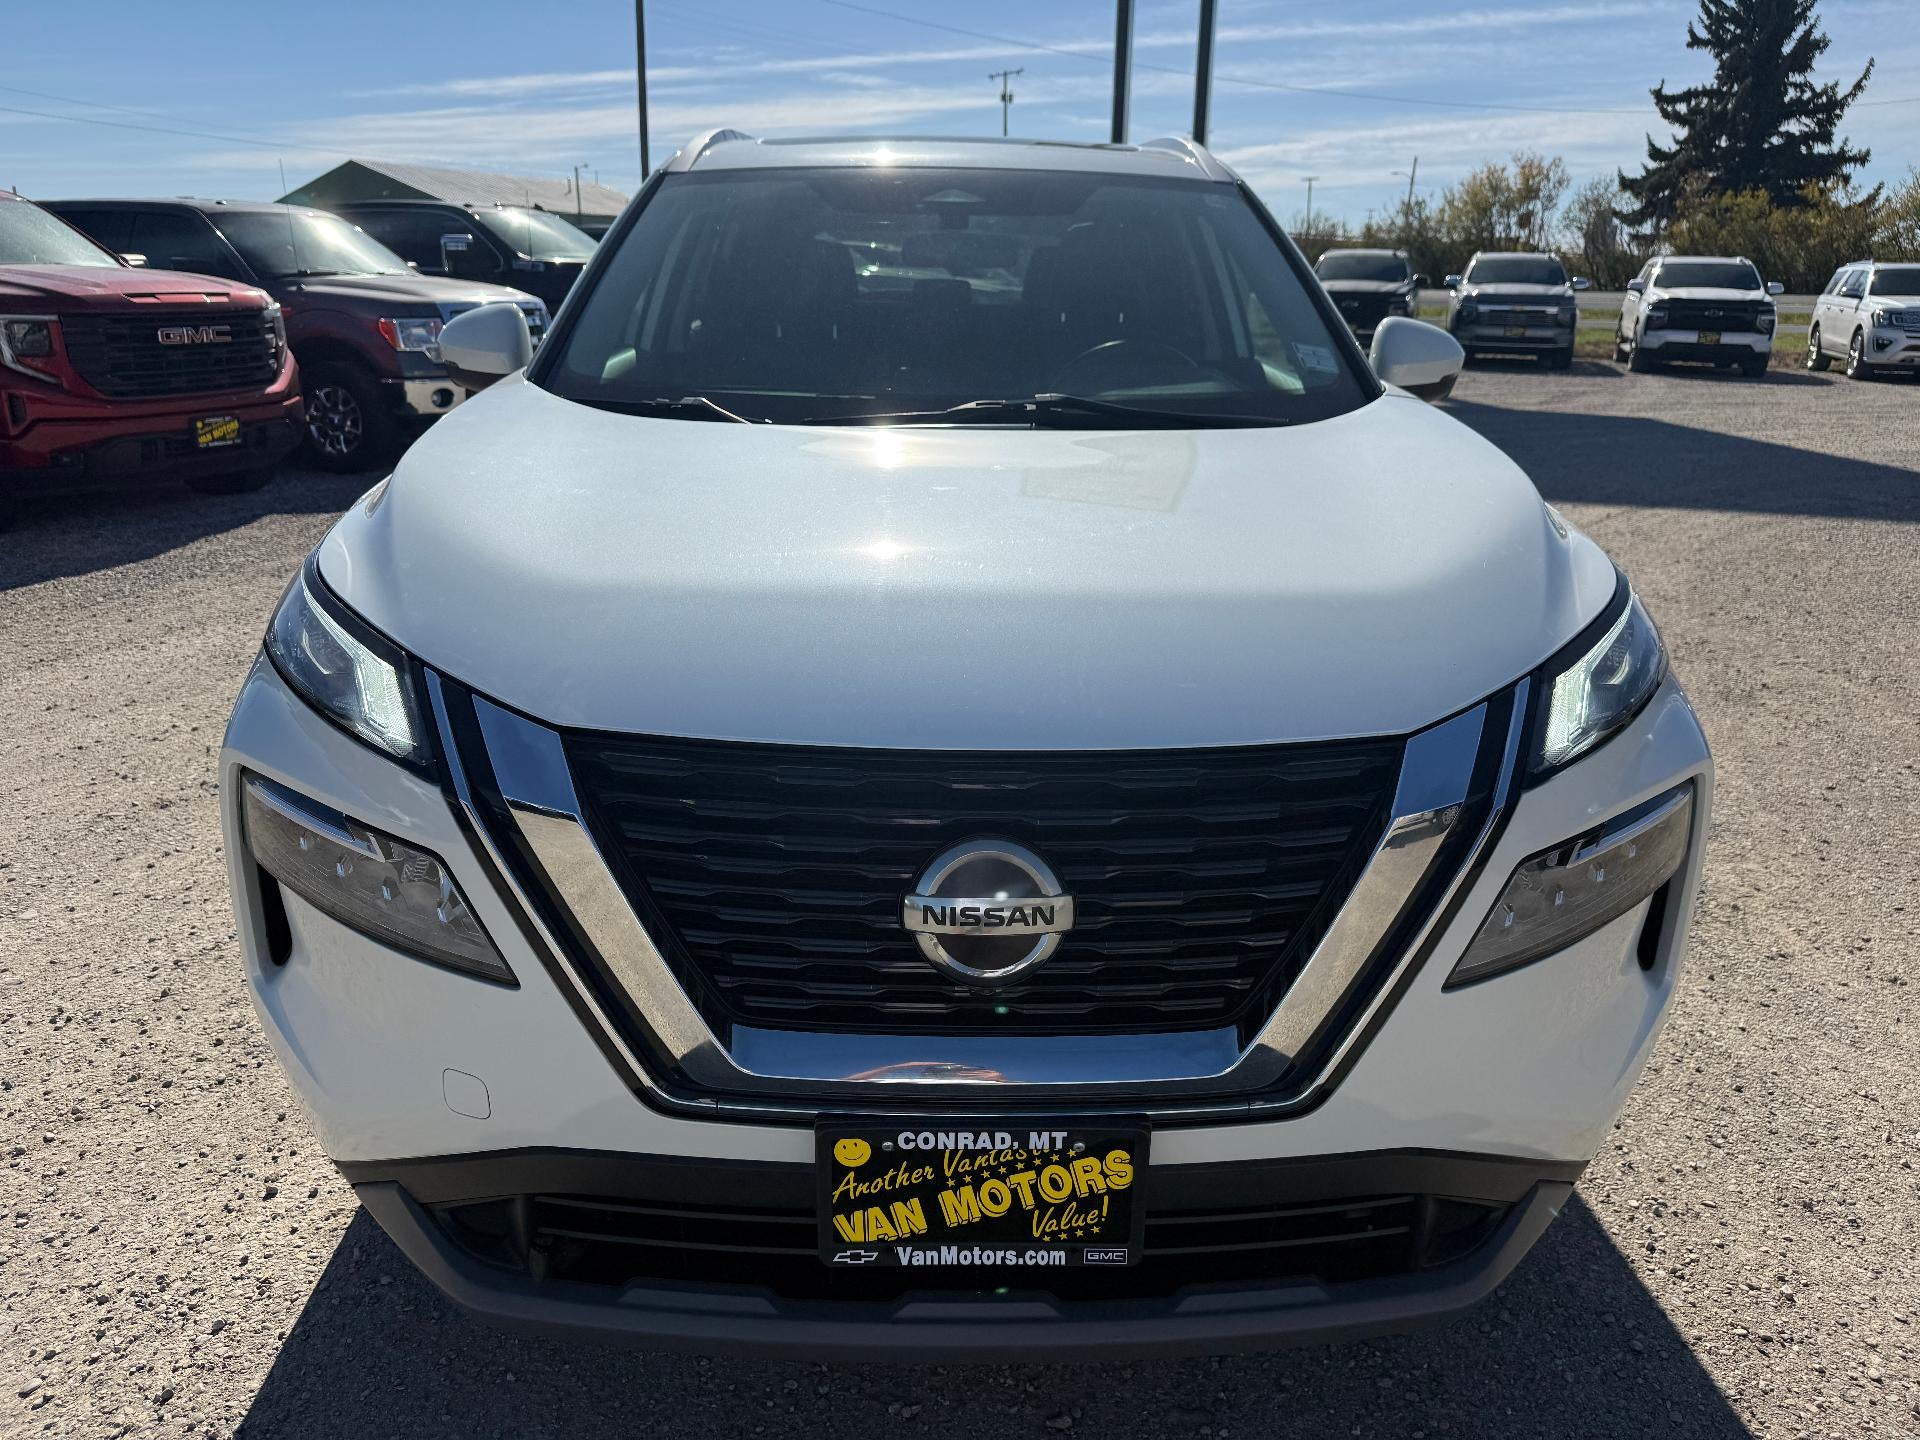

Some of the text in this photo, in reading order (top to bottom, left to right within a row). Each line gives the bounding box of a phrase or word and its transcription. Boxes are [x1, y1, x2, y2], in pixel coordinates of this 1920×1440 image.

[158, 326, 231, 344] GMC
[922, 904, 1056, 928] NISSAN
[897, 1131, 1068, 1151] CONRAD, MT
[832, 1160, 935, 1204] Another
[832, 1149, 1134, 1243] VAN MOTORS
[1032, 1194, 1109, 1238] Value!
[896, 1245, 1066, 1266] VanMotors.com
